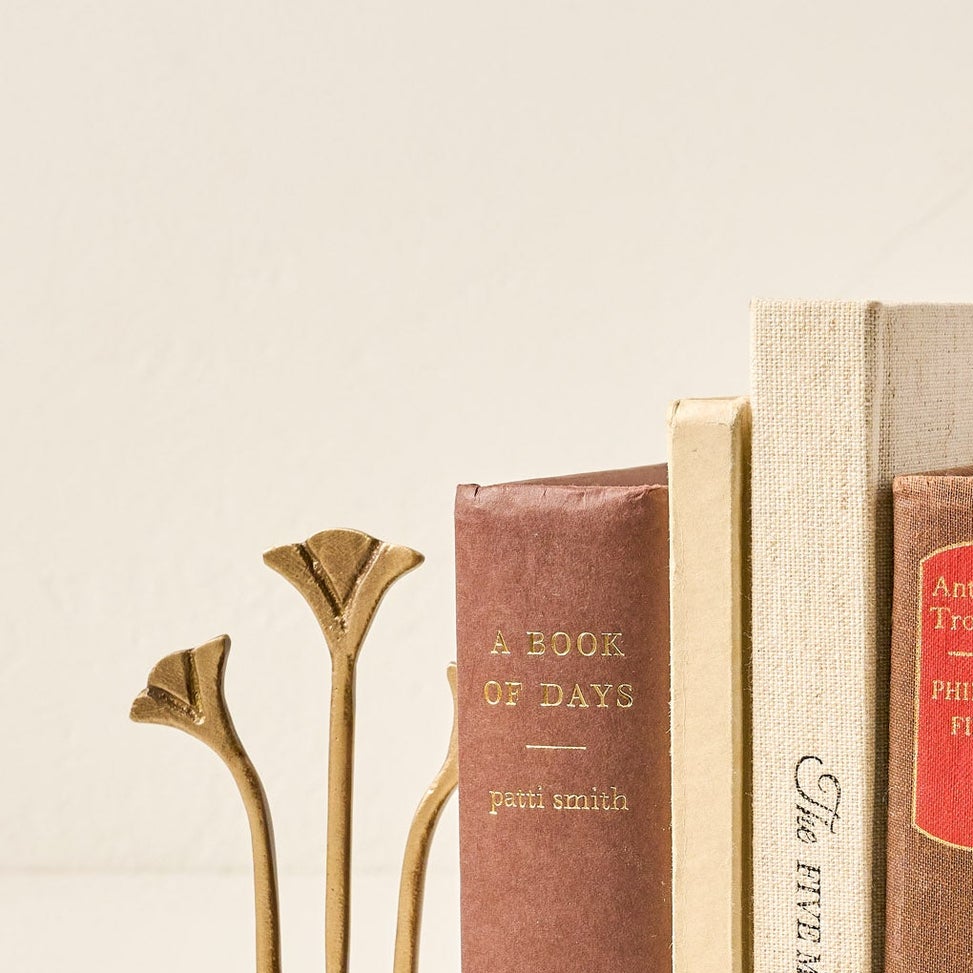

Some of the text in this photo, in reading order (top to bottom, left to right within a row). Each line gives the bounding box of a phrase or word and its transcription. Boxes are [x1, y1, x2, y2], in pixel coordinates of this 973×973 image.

[490, 630, 625, 657] A BOOK
[483, 680, 634, 709] OF DAYS
[488, 785, 630, 815] patti smith
[794, 755, 842, 844] The
[796, 860, 822, 944] FIVE
